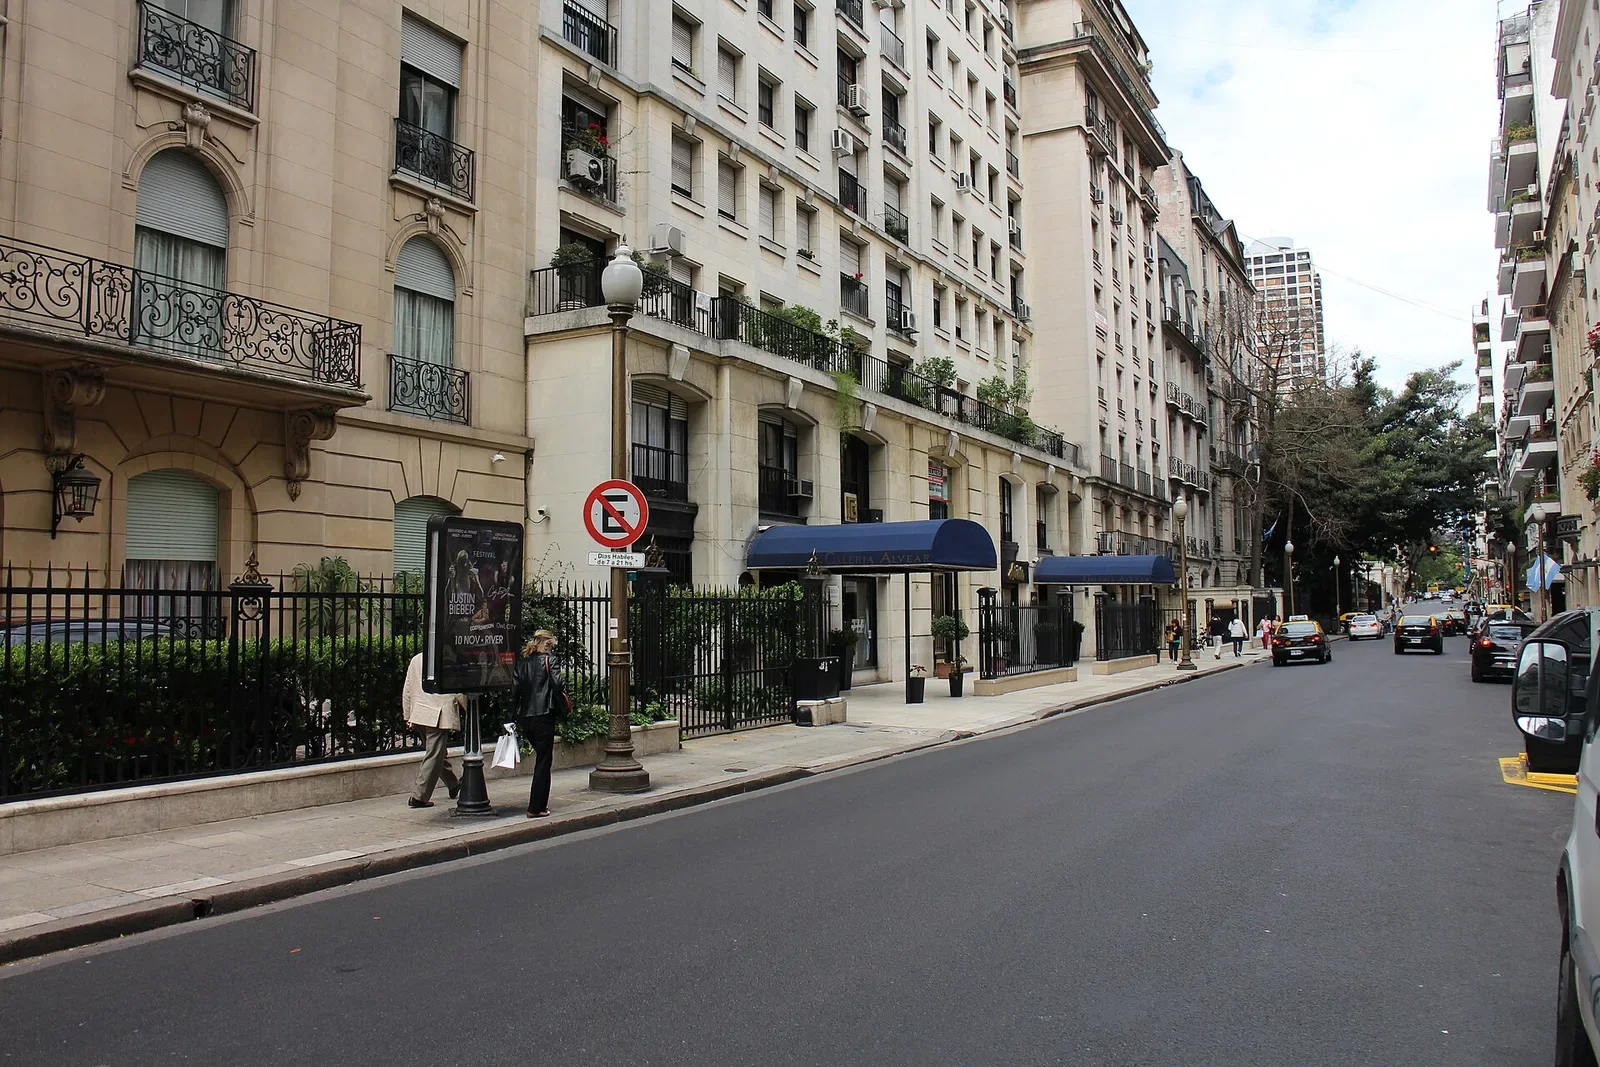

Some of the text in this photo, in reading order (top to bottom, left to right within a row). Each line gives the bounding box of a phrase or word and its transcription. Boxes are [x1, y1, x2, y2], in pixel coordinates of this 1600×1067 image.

[473, 550, 496, 559] FESTIVAL
[880, 551, 930, 564] ALVEAR
[449, 592, 475, 604] JUSTIN
[449, 604, 475, 615] BIEBER
[455, 635, 504, 645] 10 NOV RIVER
